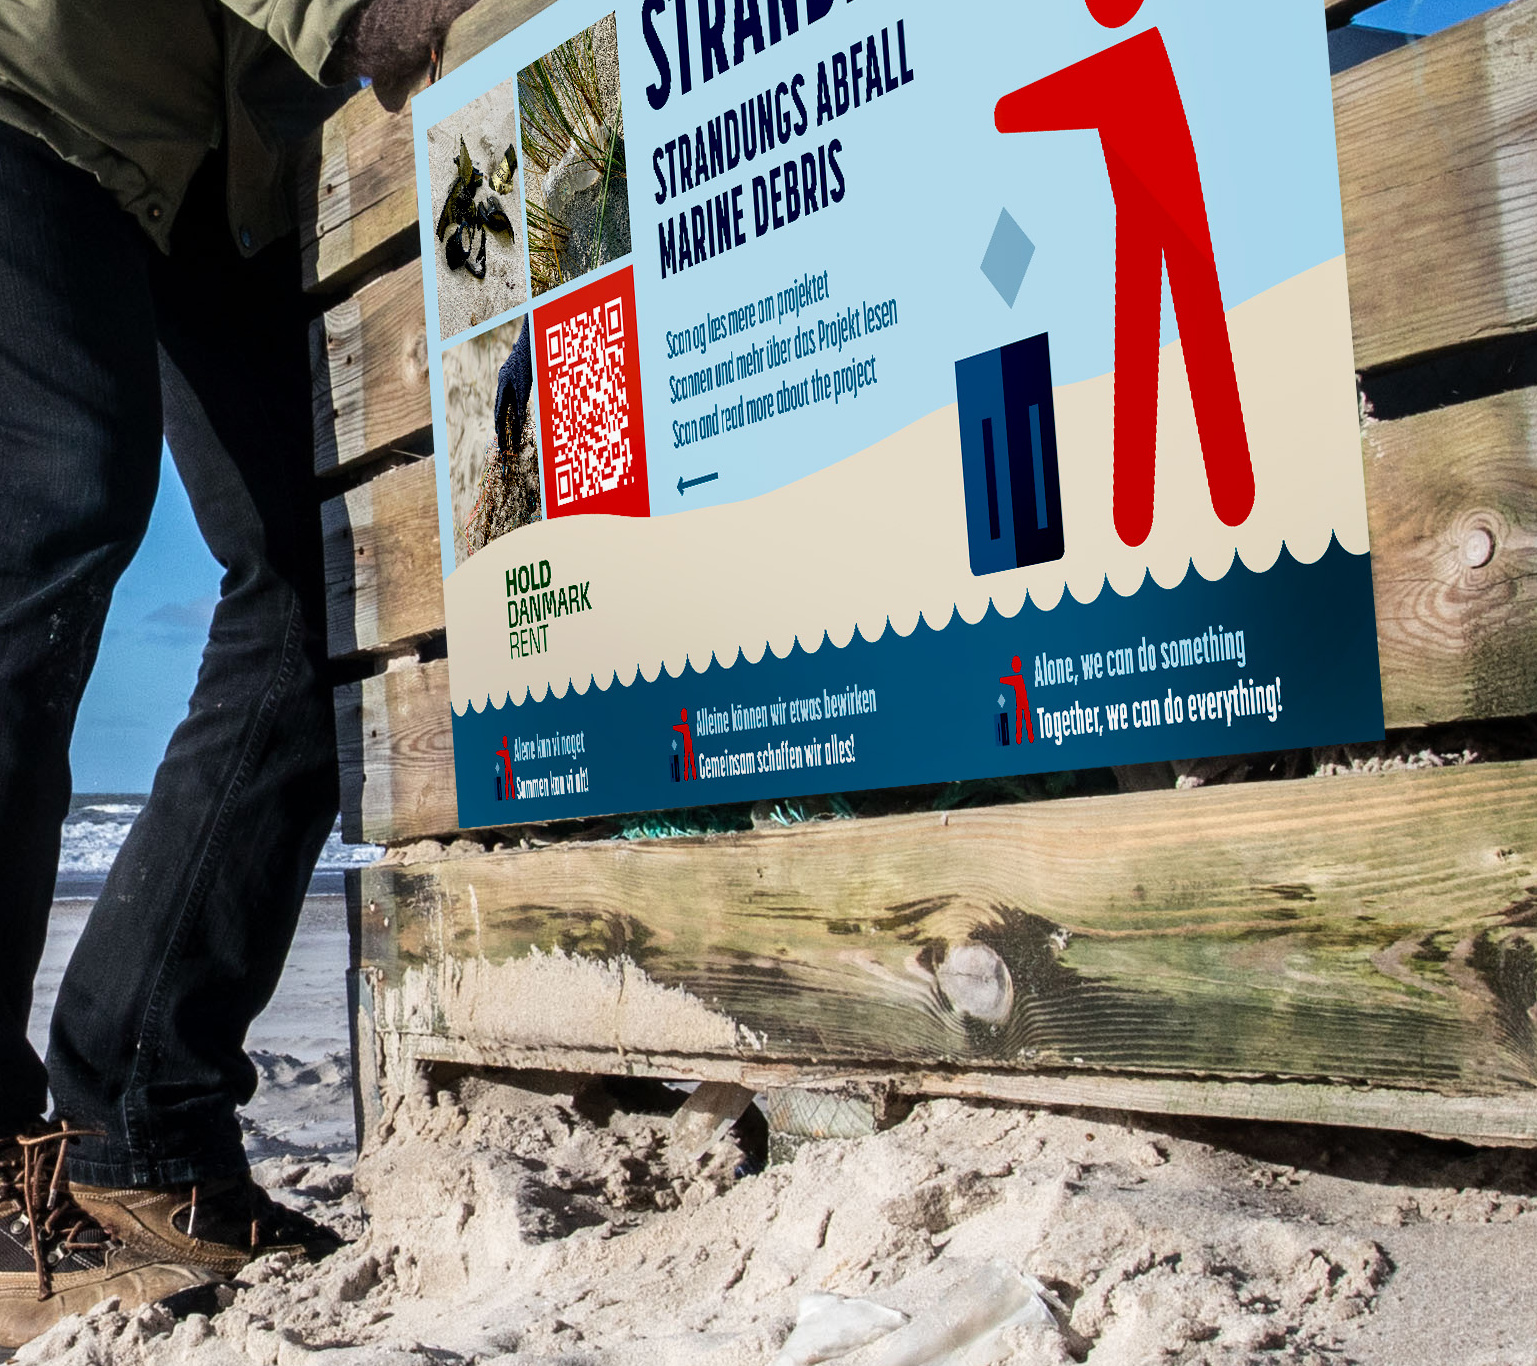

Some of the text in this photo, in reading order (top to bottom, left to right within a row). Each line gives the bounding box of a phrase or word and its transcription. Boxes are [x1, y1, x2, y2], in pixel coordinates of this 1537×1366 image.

[653, 18, 914, 205] STRANDUNGS ABFALL
[658, 138, 845, 279] MARINE DEBRIS
[666, 270, 829, 359] Scan og læs mere om projektet
[669, 299, 898, 404] Scannen und mehr über das Projekt lesen
[672, 354, 877, 448] Scan and read more about the project
[506, 559, 551, 597] HOLD
[508, 581, 592, 628] DANMARK
[510, 624, 548, 659] RENT
[1035, 625, 1246, 687] Alone, we can do something
[696, 684, 877, 736] Alleine können wir etwas bewirken
[1037, 676, 1283, 745] Together, we can do everything!
[514, 737, 535, 762] Alene
[552, 731, 560, 756] vi
[561, 731, 585, 759] noget
[699, 733, 855, 779] Gemeinsam schaffen wir alles!
[516, 777, 549, 799] Sammen
[550, 771, 565, 795] kan
[566, 768, 574, 793] vi
